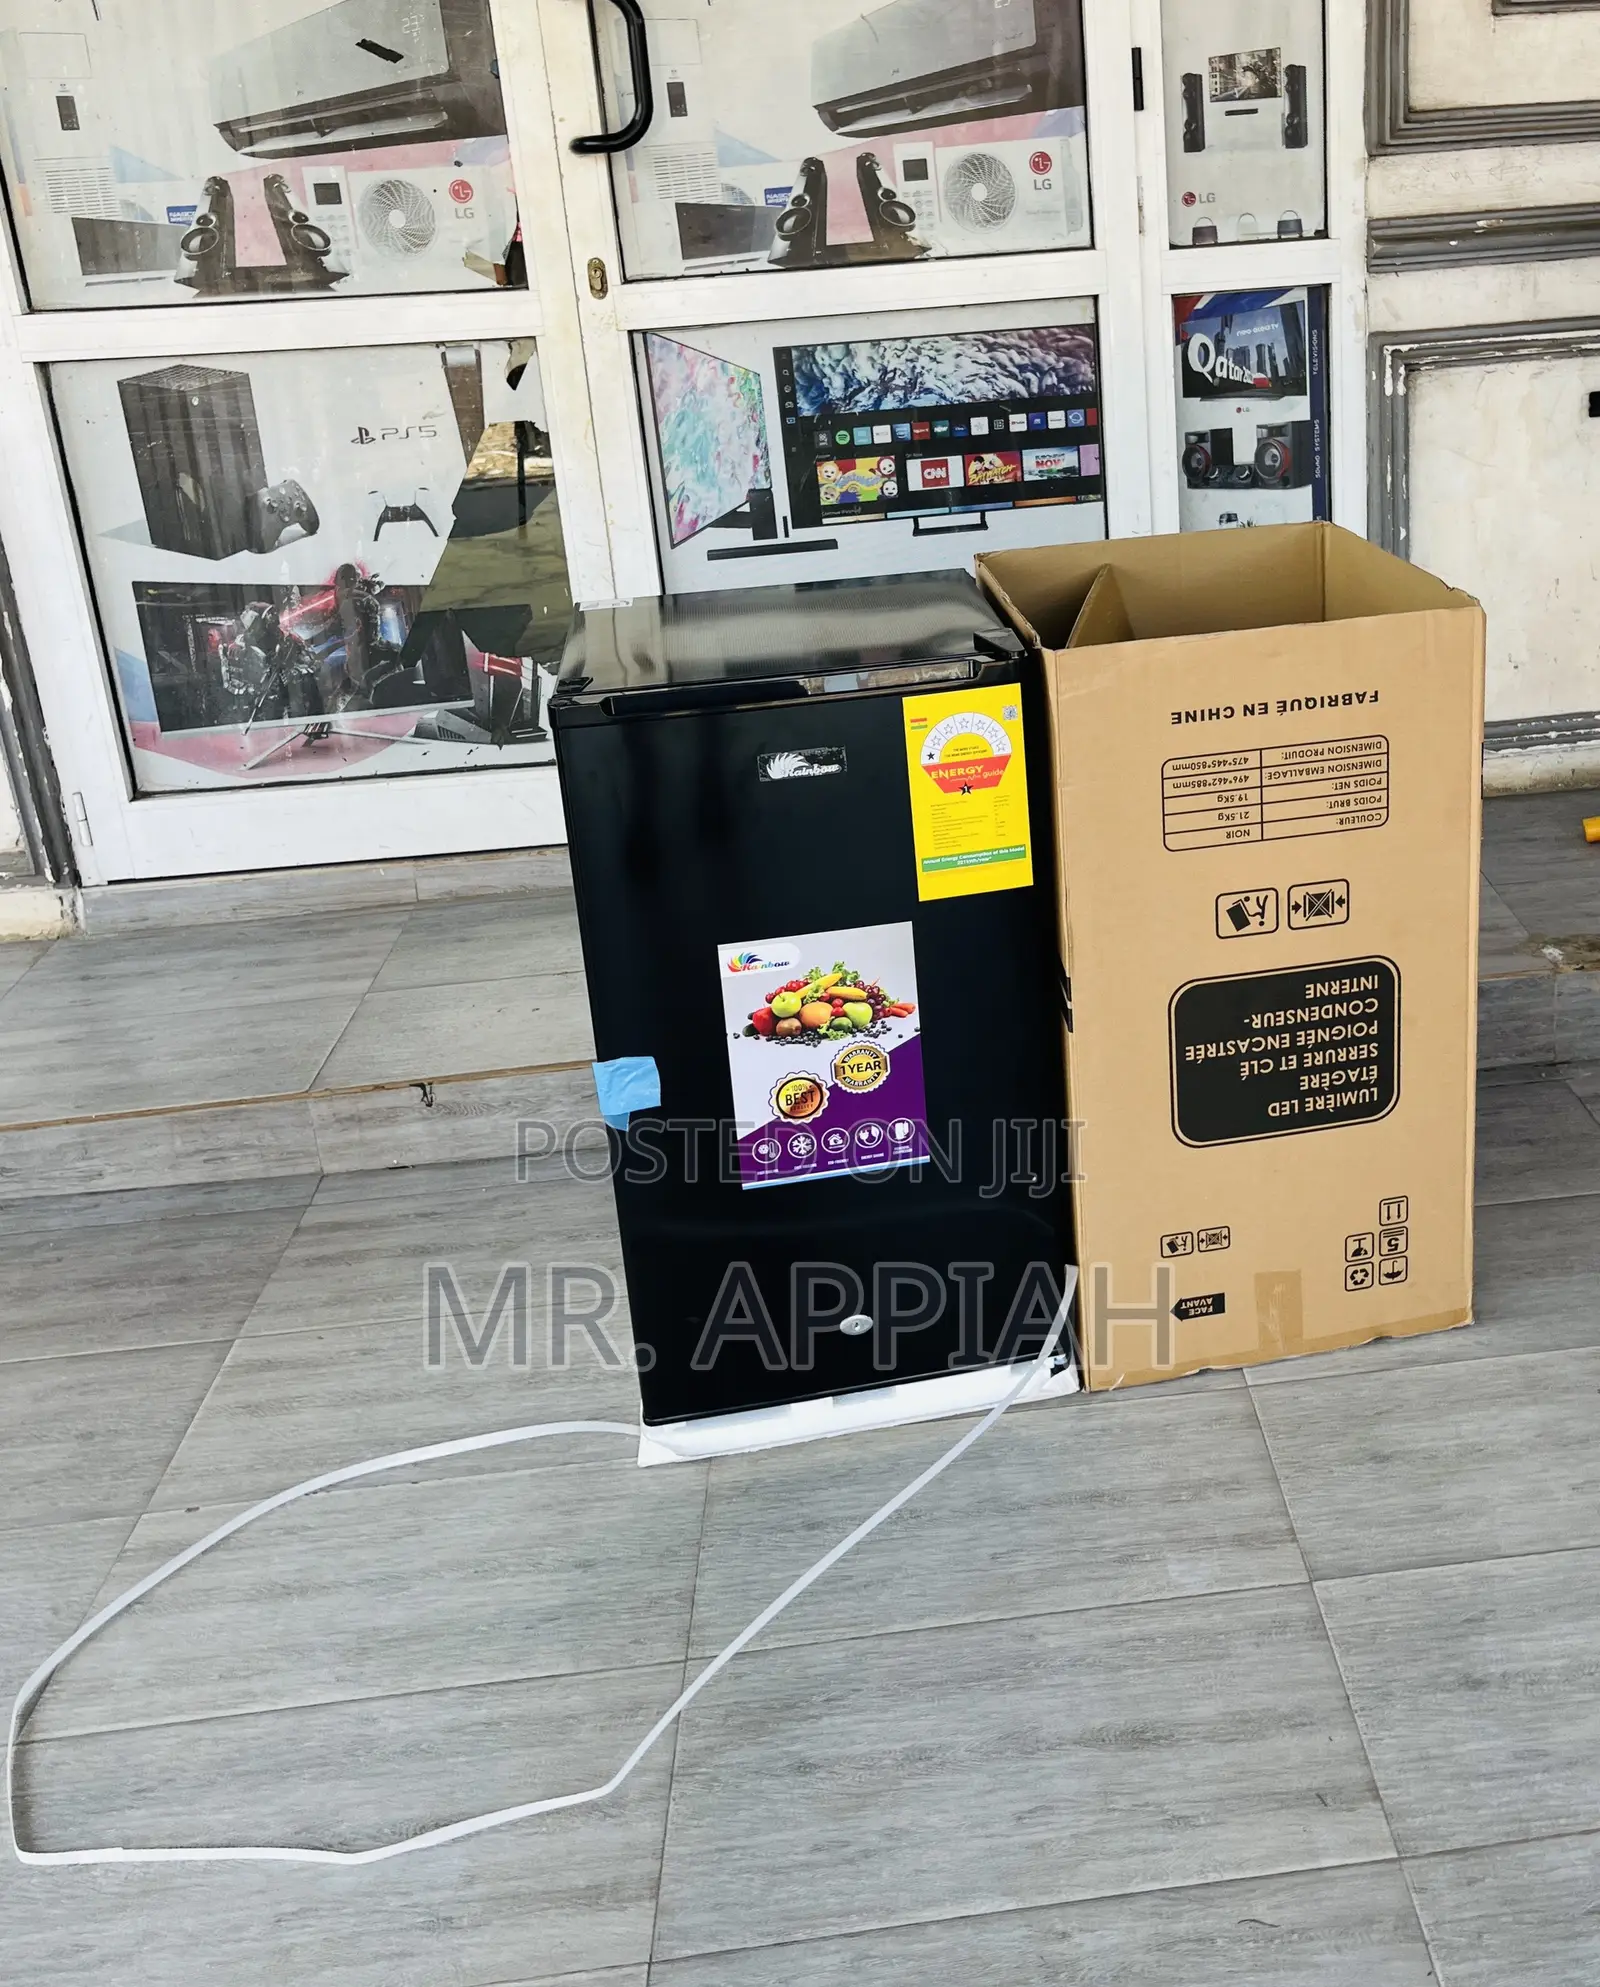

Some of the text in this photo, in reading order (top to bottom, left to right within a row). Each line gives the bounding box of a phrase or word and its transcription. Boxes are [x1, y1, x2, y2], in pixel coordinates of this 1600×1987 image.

[1033, 178, 1052, 191] LG
[1199, 192, 1216, 204] LG
[455, 207, 475, 219] LG
[1187, 332, 1244, 386] Qatar
[380, 424, 437, 440] PS5
[923, 467, 947, 480] CNN
[1170, 690, 1379, 725] FABRIQUÉ EN CHINE
[1281, 741, 1382, 760] DIMENSION PRODUIT:
[783, 763, 840, 778] Rainbow
[931, 765, 984, 780] ENERGY
[982, 769, 1004, 779] guide
[1264, 759, 1382, 780] DIMENSION EMBALLAGE:
[1332, 777, 1382, 790] POIDS NET:
[1217, 792, 1248, 804] 19.5Kg
[1326, 794, 1382, 809] POIDS BRUT:
[1217, 810, 1250, 822] 21.5Kg
[1336, 812, 1382, 826] COULEUR:
[1226, 828, 1250, 839] NOIR
[1305, 974, 1378, 998] INTERNE
[1244, 998, 1378, 1029] CONDENSEUR-
[1185, 1020, 1378, 1064] POIGNÉE ENCASTRÉE
[840, 1060, 882, 1075] 1 YEAR
[1240, 1042, 1378, 1080] SERRURE ET CLÉ
[1299, 1065, 1378, 1090] ÉTAGÈRE
[785, 1090, 815, 1106] BEST
[1268, 1087, 1378, 1116] LUMIÈRE LED
[1180, 1297, 1213, 1310] AVANT
[1188, 1305, 1213, 1316] FACE
